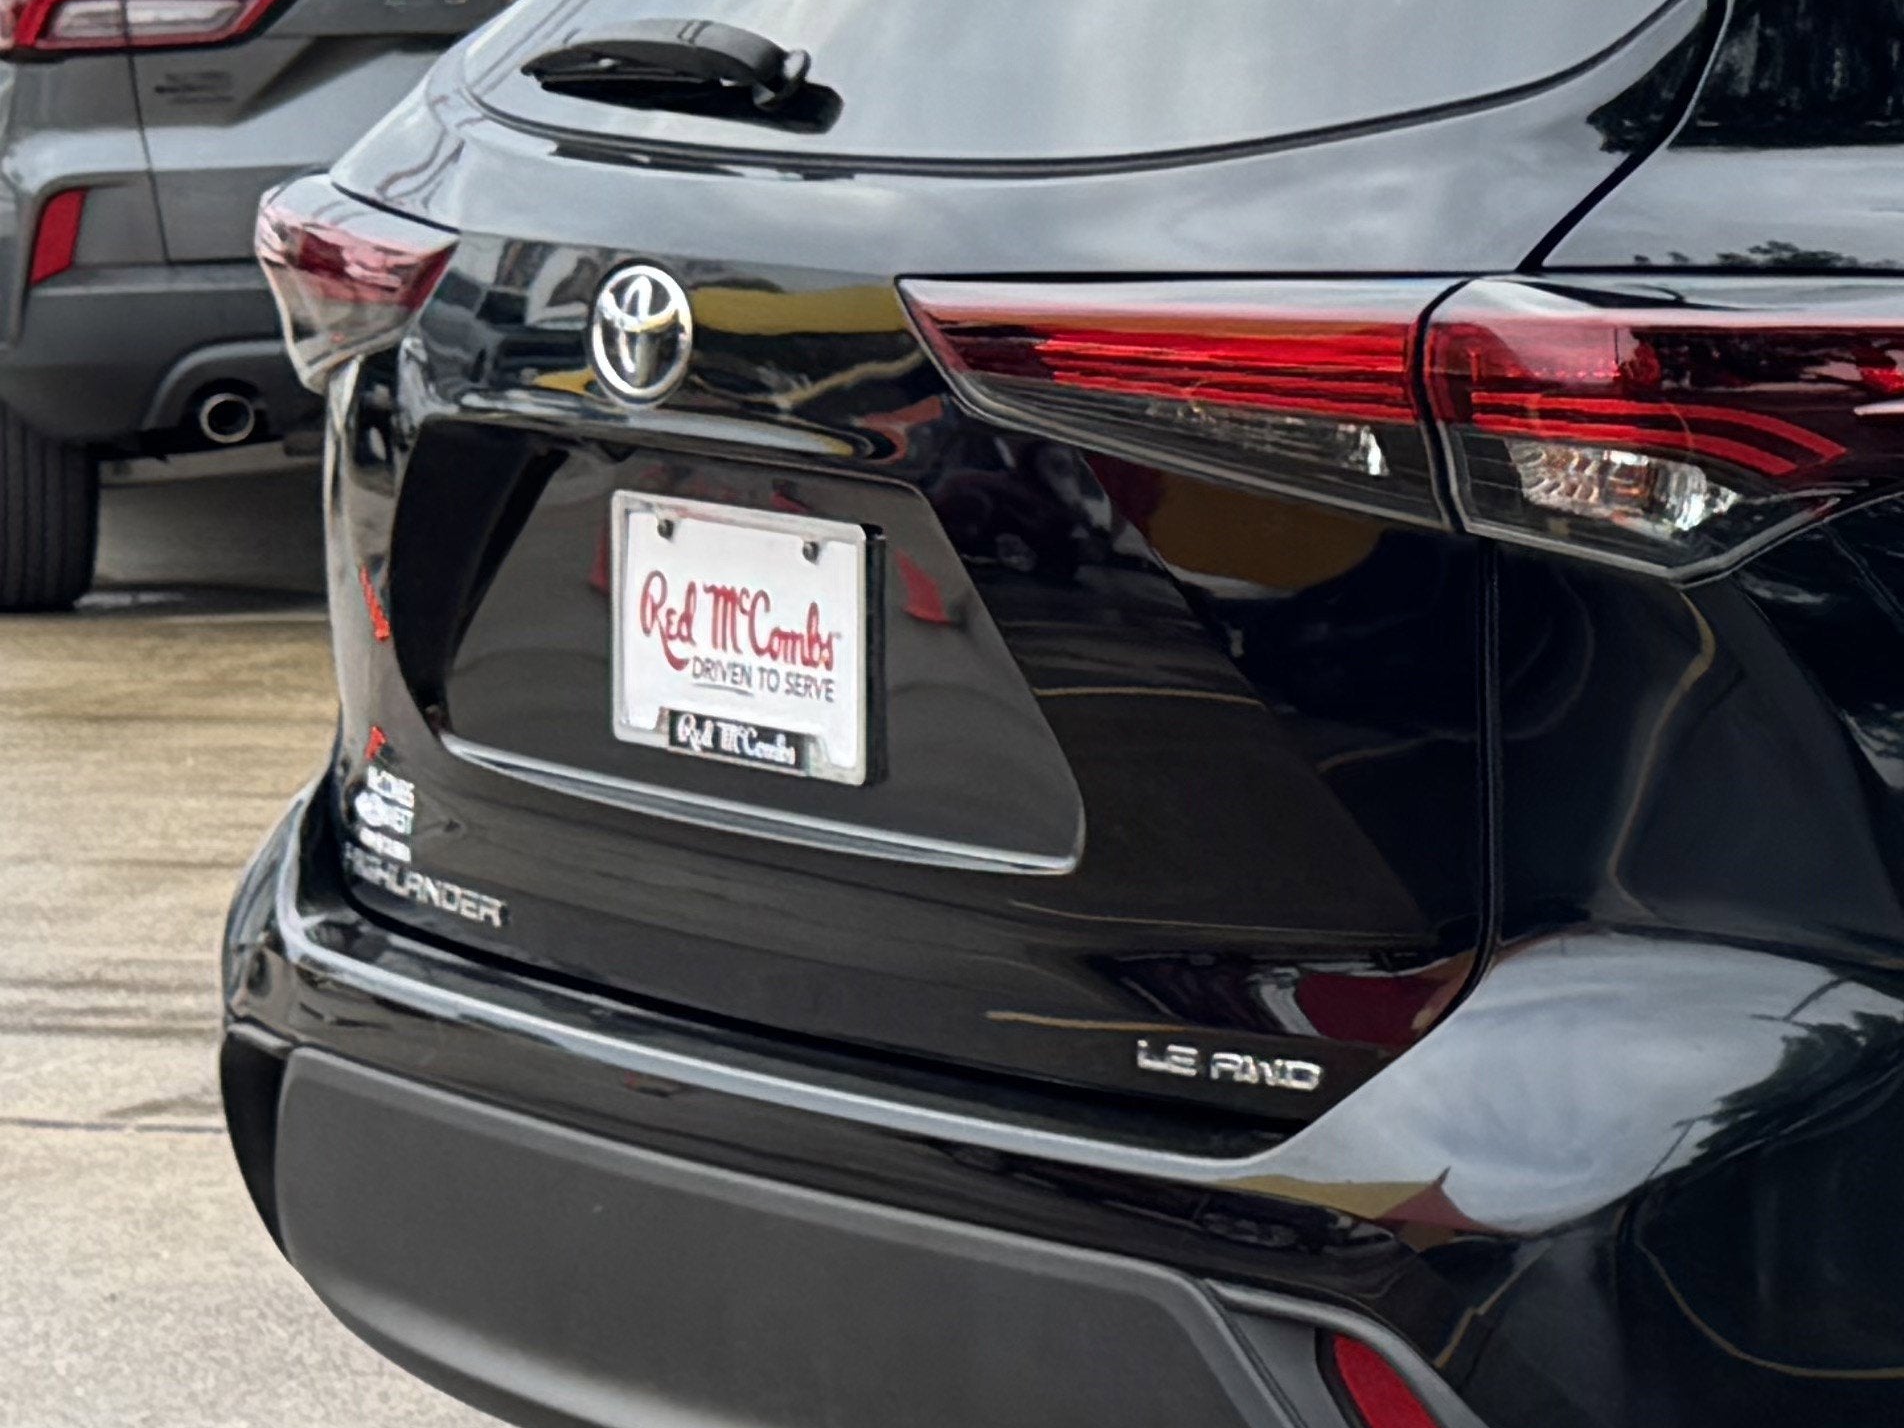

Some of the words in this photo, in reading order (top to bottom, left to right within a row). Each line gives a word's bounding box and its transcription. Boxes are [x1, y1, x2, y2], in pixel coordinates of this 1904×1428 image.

[639, 569, 698, 671] Red
[702, 581, 836, 671] McCombs
[691, 655, 753, 688] DRIVEN
[757, 665, 781, 694] TO
[784, 671, 835, 704] SERVE
[1136, 1038, 1199, 1077] LE
[1209, 1051, 1324, 1091] AWD
